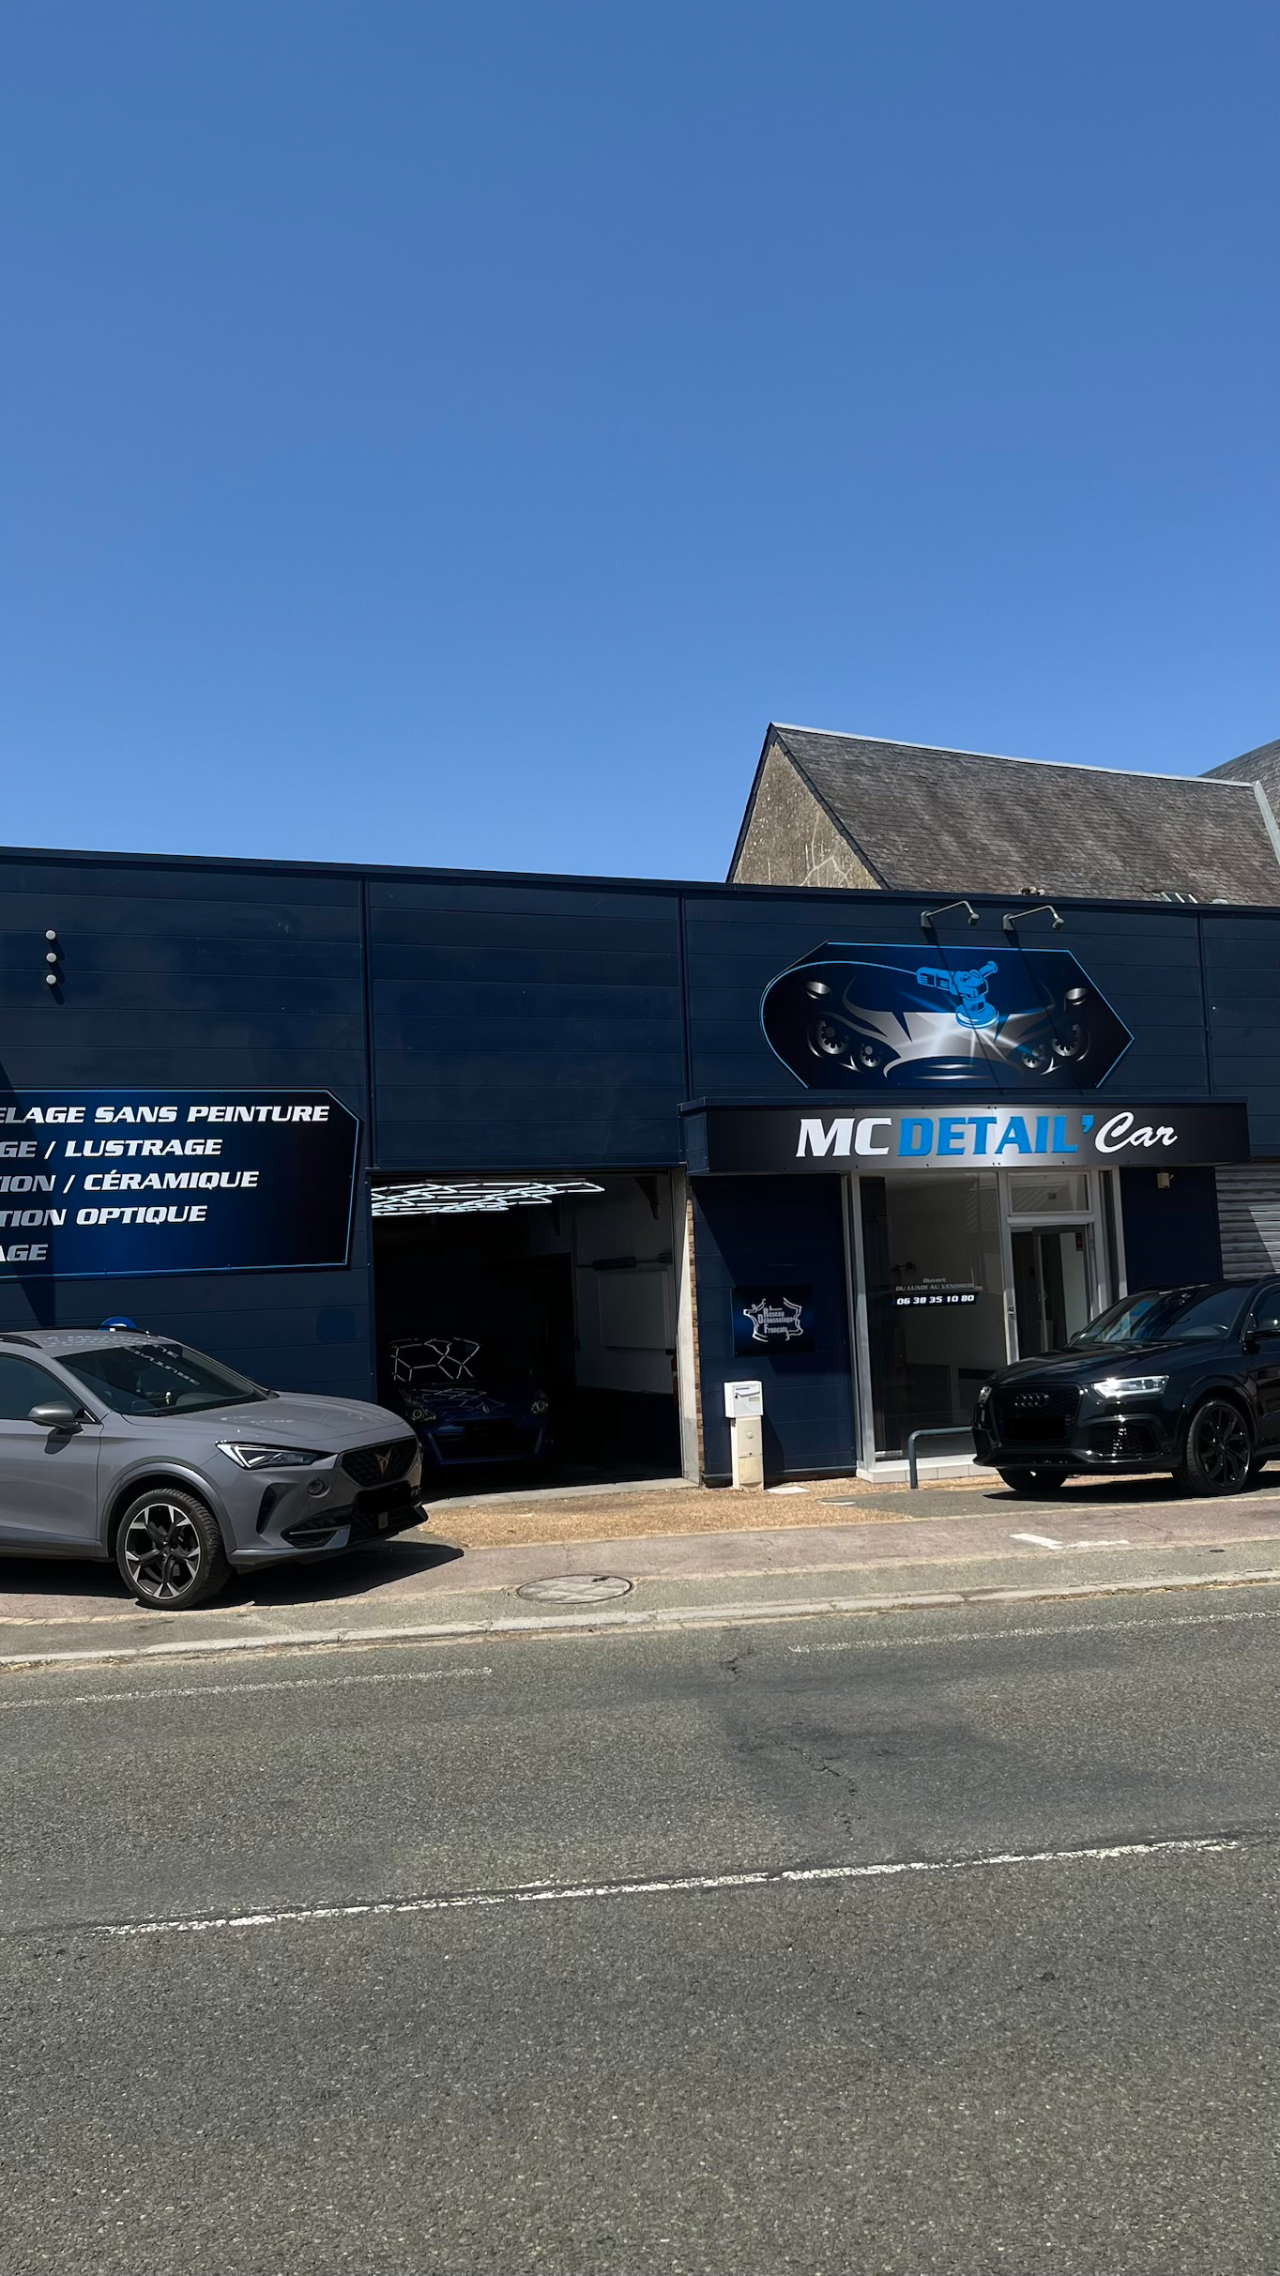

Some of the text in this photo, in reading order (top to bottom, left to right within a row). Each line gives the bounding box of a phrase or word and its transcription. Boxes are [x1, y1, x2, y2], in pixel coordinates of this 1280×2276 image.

[95, 1106, 178, 1123] SANS
[187, 1105, 330, 1122] PEINTURE
[796, 1117, 892, 1157] MC
[1095, 1111, 1178, 1153] Car
[44, 1140, 56, 1160] /
[65, 1139, 223, 1157] LUSTRAGE
[0, 1169, 259, 1194] ION / CÉRAMIQUE
[76, 1205, 208, 1225] OPTIQUE
[897, 1294, 975, 1305] 06 38 35 10 80
